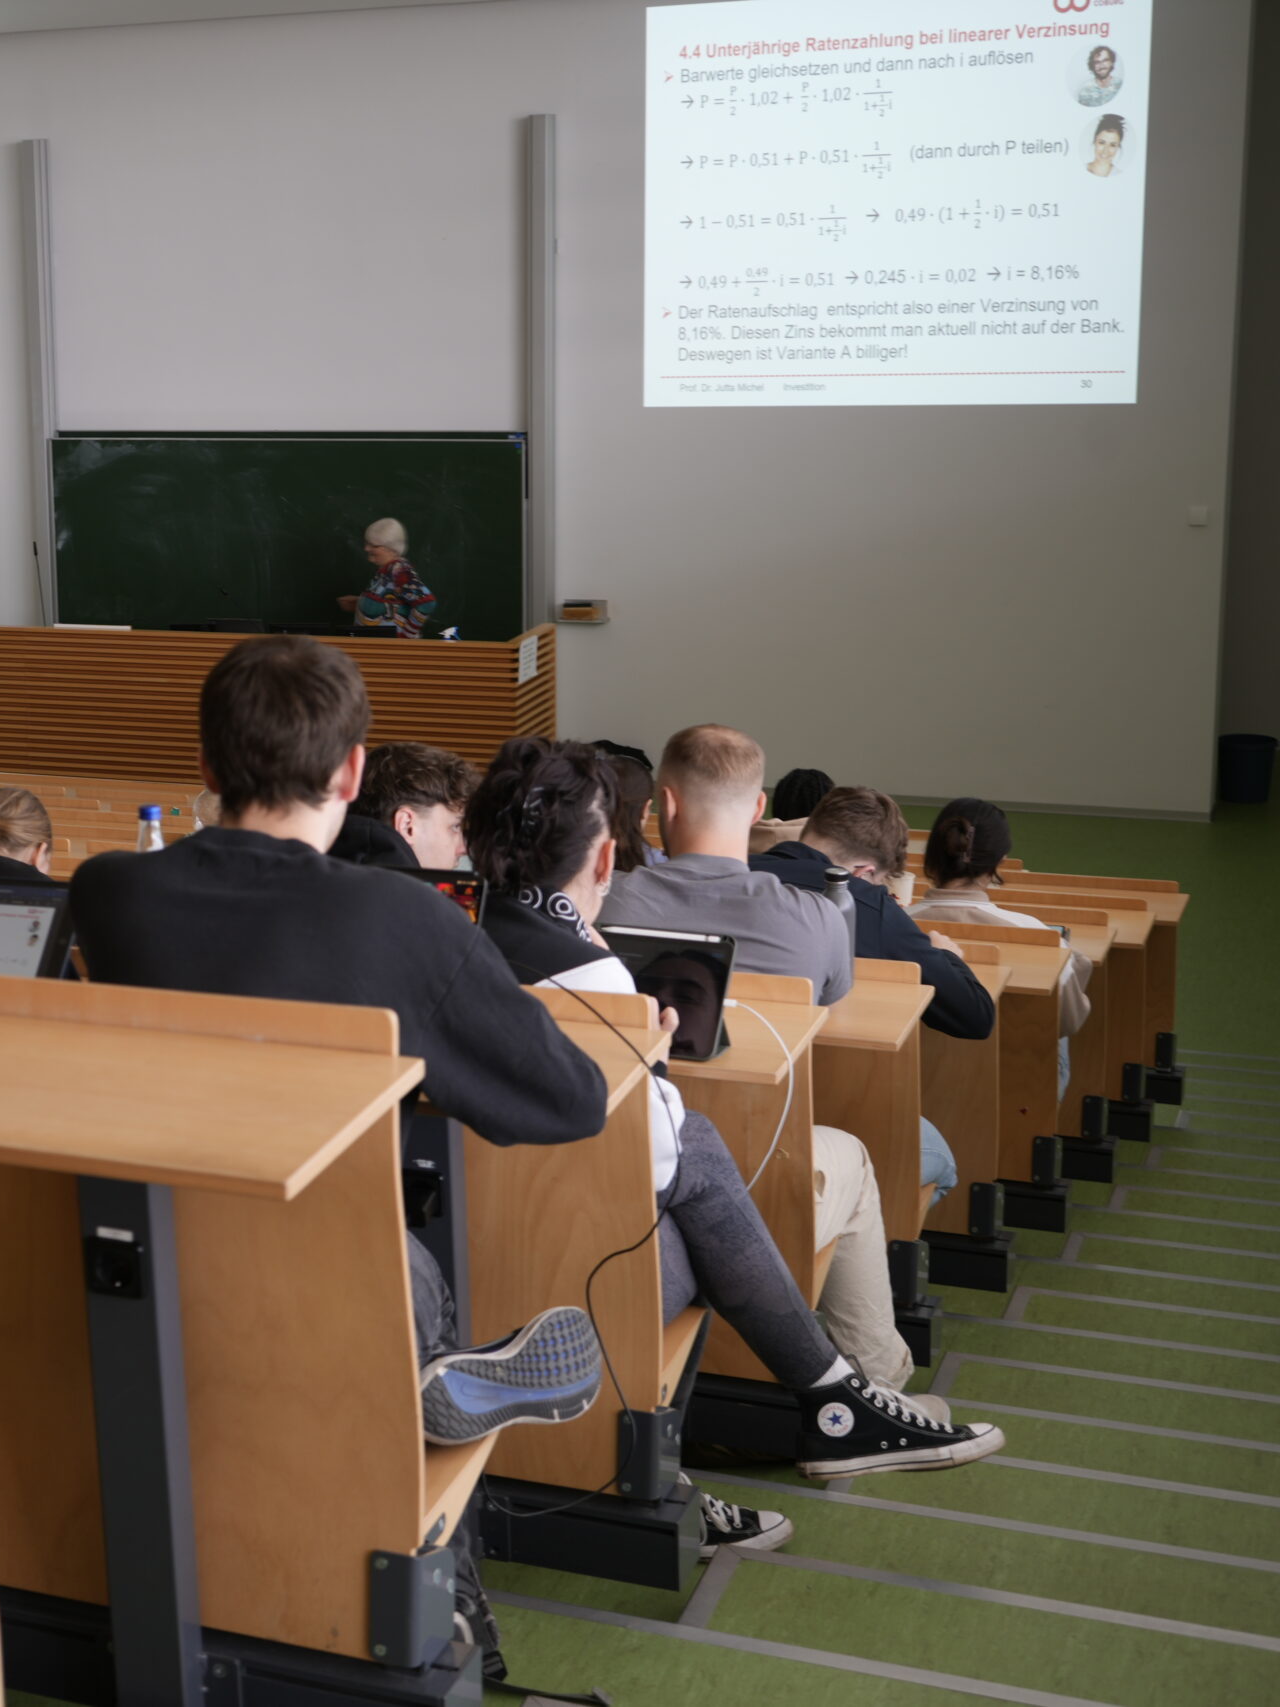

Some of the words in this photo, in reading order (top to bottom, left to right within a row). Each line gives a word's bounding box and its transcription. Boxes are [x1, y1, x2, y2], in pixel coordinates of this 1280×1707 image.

[679, 46, 701, 58] 4.4
[706, 40, 800, 59] Unterjährige
[806, 33, 913, 52] Ratenzahlung
[920, 30, 943, 45] bei
[949, 28, 1010, 43] linearer
[1015, 22, 1110, 38] Verzinsung
[680, 67, 744, 83] Barwerte
[749, 63, 838, 83] gleichsetzen
[844, 59, 871, 73] und
[876, 57, 914, 72] dann
[918, 54, 955, 69] nach
[960, 54, 964, 67] i
[969, 51, 1034, 66] auflösen
[700, 95, 708, 108] P
[750, 91, 779, 107] 1,02
[822, 87, 851, 103] 1,02
[699, 156, 708, 168] P
[729, 154, 738, 167] P
[750, 153, 779, 168] 0,51
[799, 151, 808, 164] P
[820, 150, 849, 165] 0,51
[910, 145, 952, 163] (dann
[958, 142, 1000, 157] durch
[1005, 141, 1016, 155] P
[1022, 138, 1069, 156] teilen)
[726, 214, 755, 229] 0,51
[777, 213, 805, 228] 0,51
[895, 208, 926, 224] 0,49
[1029, 204, 1059, 219] 0,51
[698, 275, 727, 291] 0,49
[805, 273, 834, 288] 0,51
[864, 270, 907, 286] 0,245
[946, 269, 976, 284] 0,02
[1031, 264, 1080, 282] 8,16%
[679, 305, 704, 319] Der
[708, 303, 818, 321] Ratenaufschlag
[827, 301, 898, 320] entspricht
[903, 300, 933, 314] also
[938, 300, 976, 314] einer
[980, 299, 1066, 315] Verzinsung
[1071, 299, 1099, 311] von
[678, 327, 725, 342] 8,16%.
[732, 326, 780, 339] Diesen
[785, 325, 815, 339] Zins
[820, 324, 887, 338] bekommt
[892, 324, 923, 336] man
[928, 322, 976, 336] aktuell
[981, 320, 1017, 335] nicht
[1022, 320, 1046, 334] auf
[1051, 320, 1075, 334] der
[1081, 318, 1124, 333] Bank.
[678, 348, 751, 364] Deswegen
[756, 347, 772, 360] ist
[777, 346, 836, 360] Variante
[840, 345, 852, 359] A
[856, 344, 908, 362] billiger!
